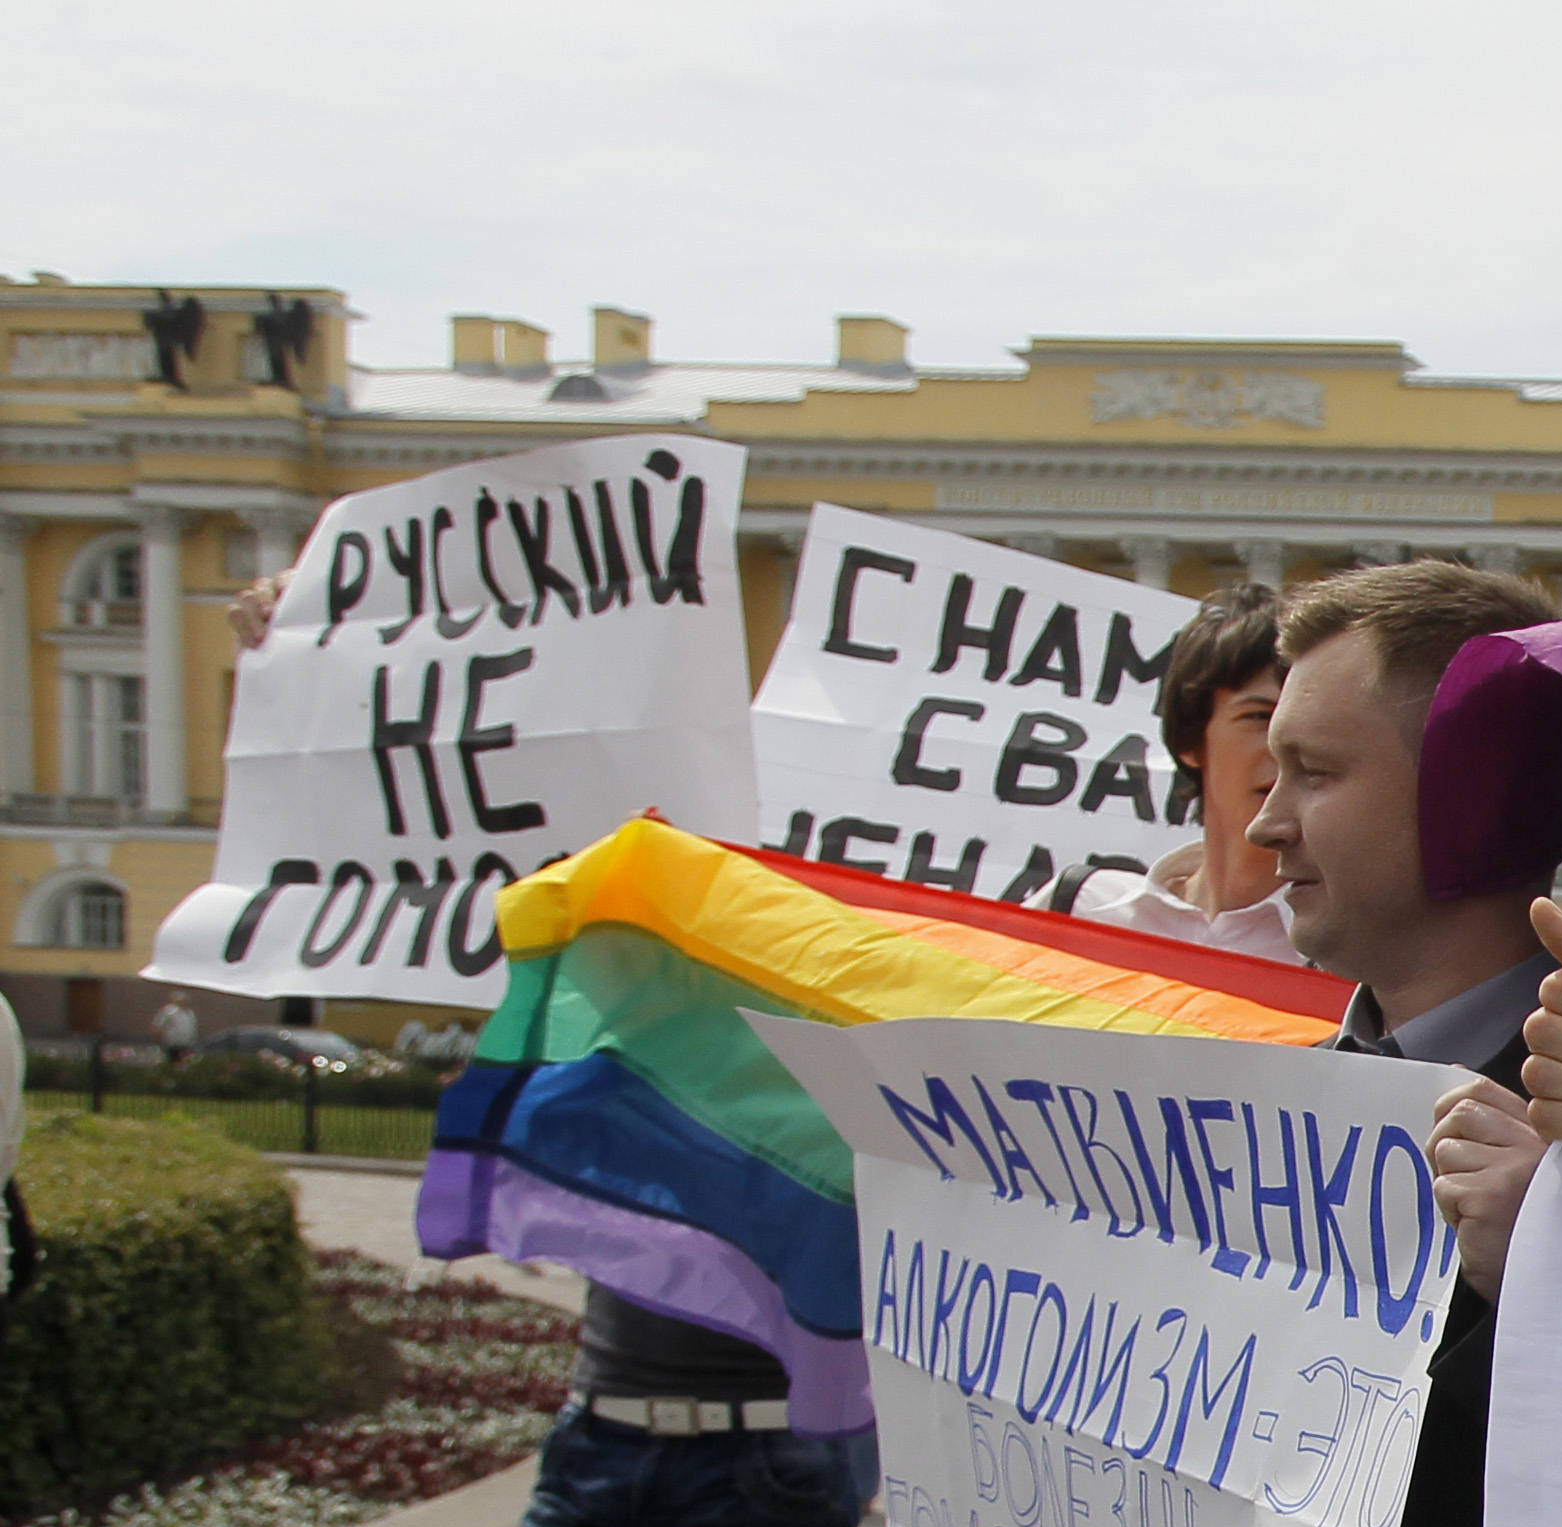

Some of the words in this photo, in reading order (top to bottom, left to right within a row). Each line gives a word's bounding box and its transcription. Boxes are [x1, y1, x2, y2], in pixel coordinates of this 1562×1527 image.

[317, 448, 706, 648] РУССКИЙ
[369, 646, 548, 840] НЕ
[224, 851, 575, 977] ГОМО
[875, 1072, 1458, 1344] МАТВИЕНКО!
[872, 1228, 1260, 1490] АЛКОГОЛИЗМ
